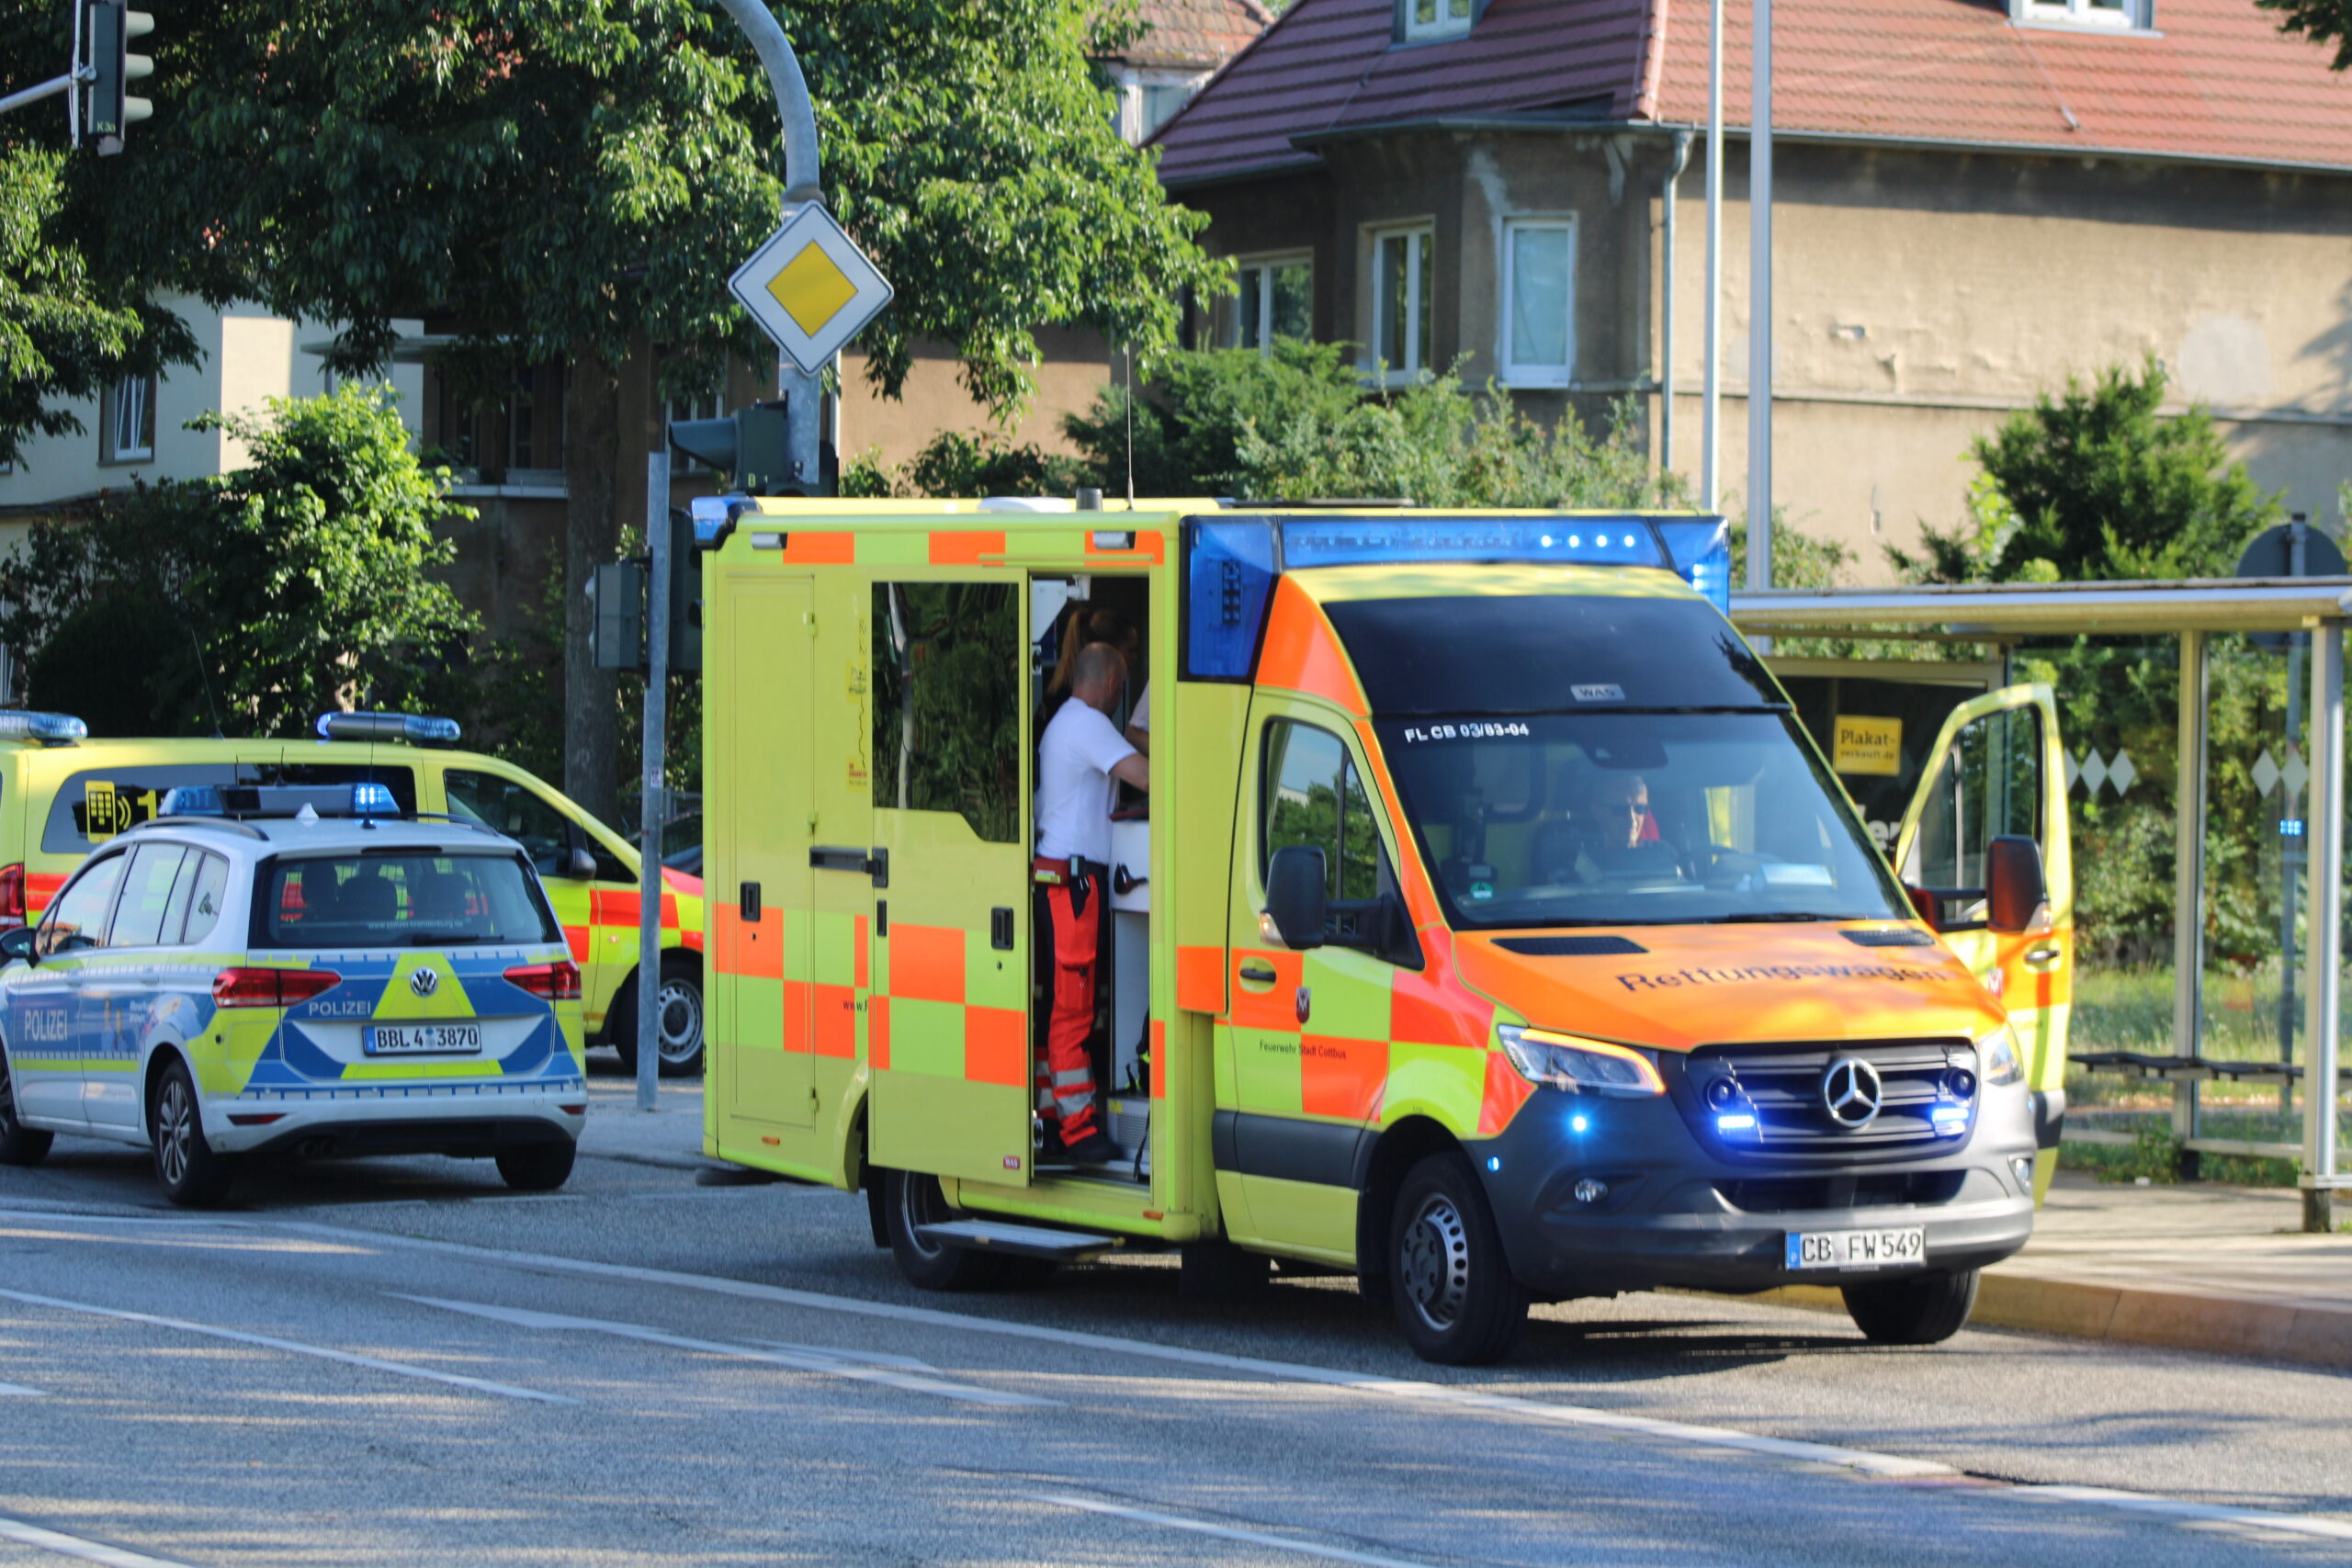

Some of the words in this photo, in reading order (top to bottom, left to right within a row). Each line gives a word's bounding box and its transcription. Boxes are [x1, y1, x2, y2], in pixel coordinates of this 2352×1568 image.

[1405, 728, 1429, 742] FL
[1430, 725, 1456, 739] CB
[1616, 965, 1955, 993] Rettungswagen
[309, 1000, 371, 1017] POLIZEI
[25, 1010, 68, 1041] POLIZEI
[377, 1030, 410, 1048] BBL
[414, 1029, 424, 1047] 4
[436, 1027, 478, 1047] 3870
[1260, 1039, 1295, 1055] Feuerwehr
[1298, 1043, 1316, 1056] Stadt
[1803, 1237, 1832, 1262] CB
[1849, 1235, 1876, 1259] FW
[1882, 1233, 1921, 1258] 549
